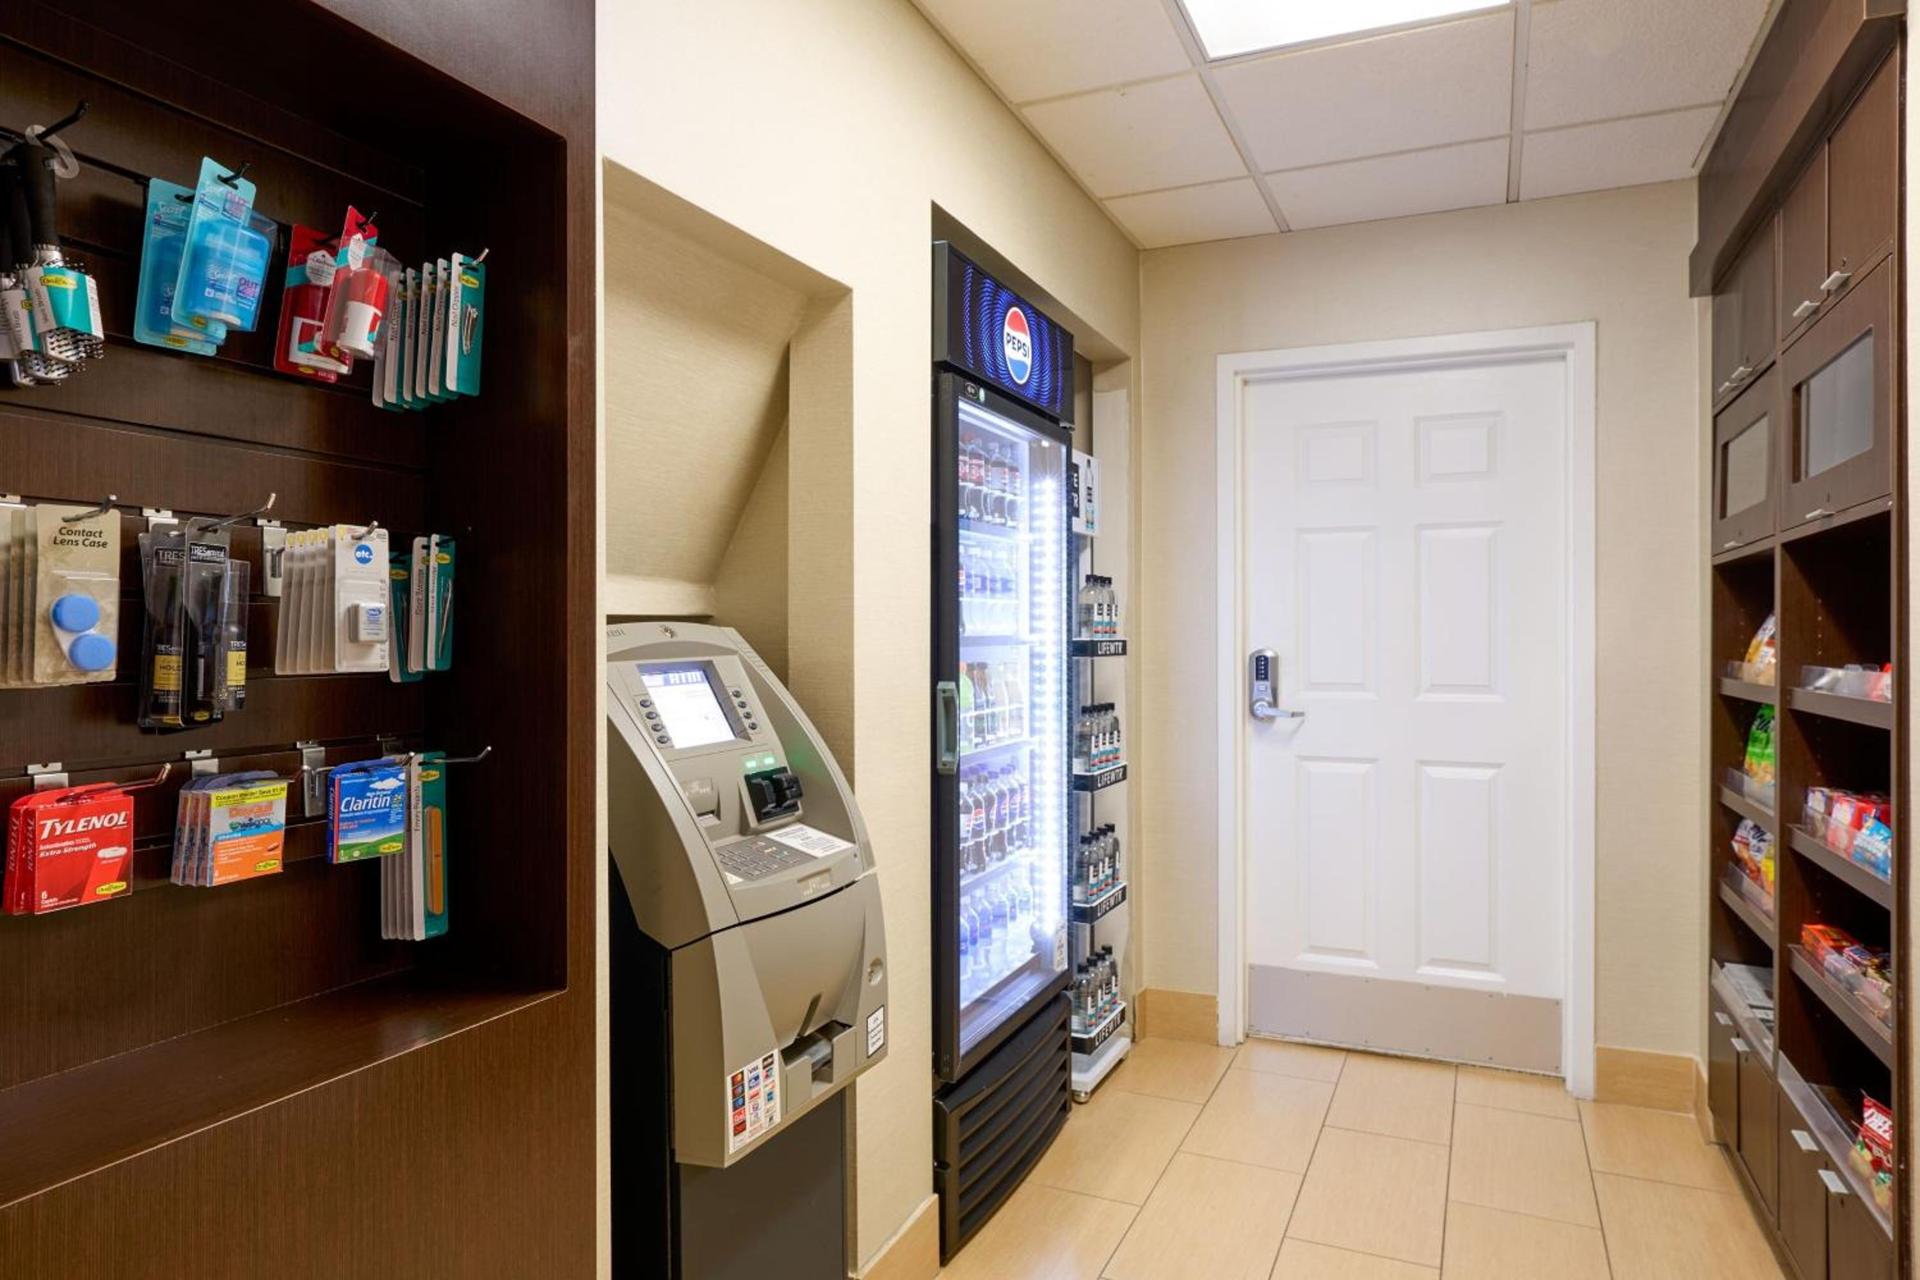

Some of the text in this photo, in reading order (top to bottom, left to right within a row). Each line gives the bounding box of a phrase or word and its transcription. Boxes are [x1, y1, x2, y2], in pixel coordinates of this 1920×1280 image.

[1006, 332, 1030, 359] PEPSI
[58, 526, 103, 538] Contact
[53, 536, 109, 548] Lens Case
[1098, 642, 1123, 655] LIFEWTR
[1098, 770, 1123, 787] LIFEWTR
[341, 795, 391, 812] Claritin
[40, 811, 129, 840] TYLENOL
